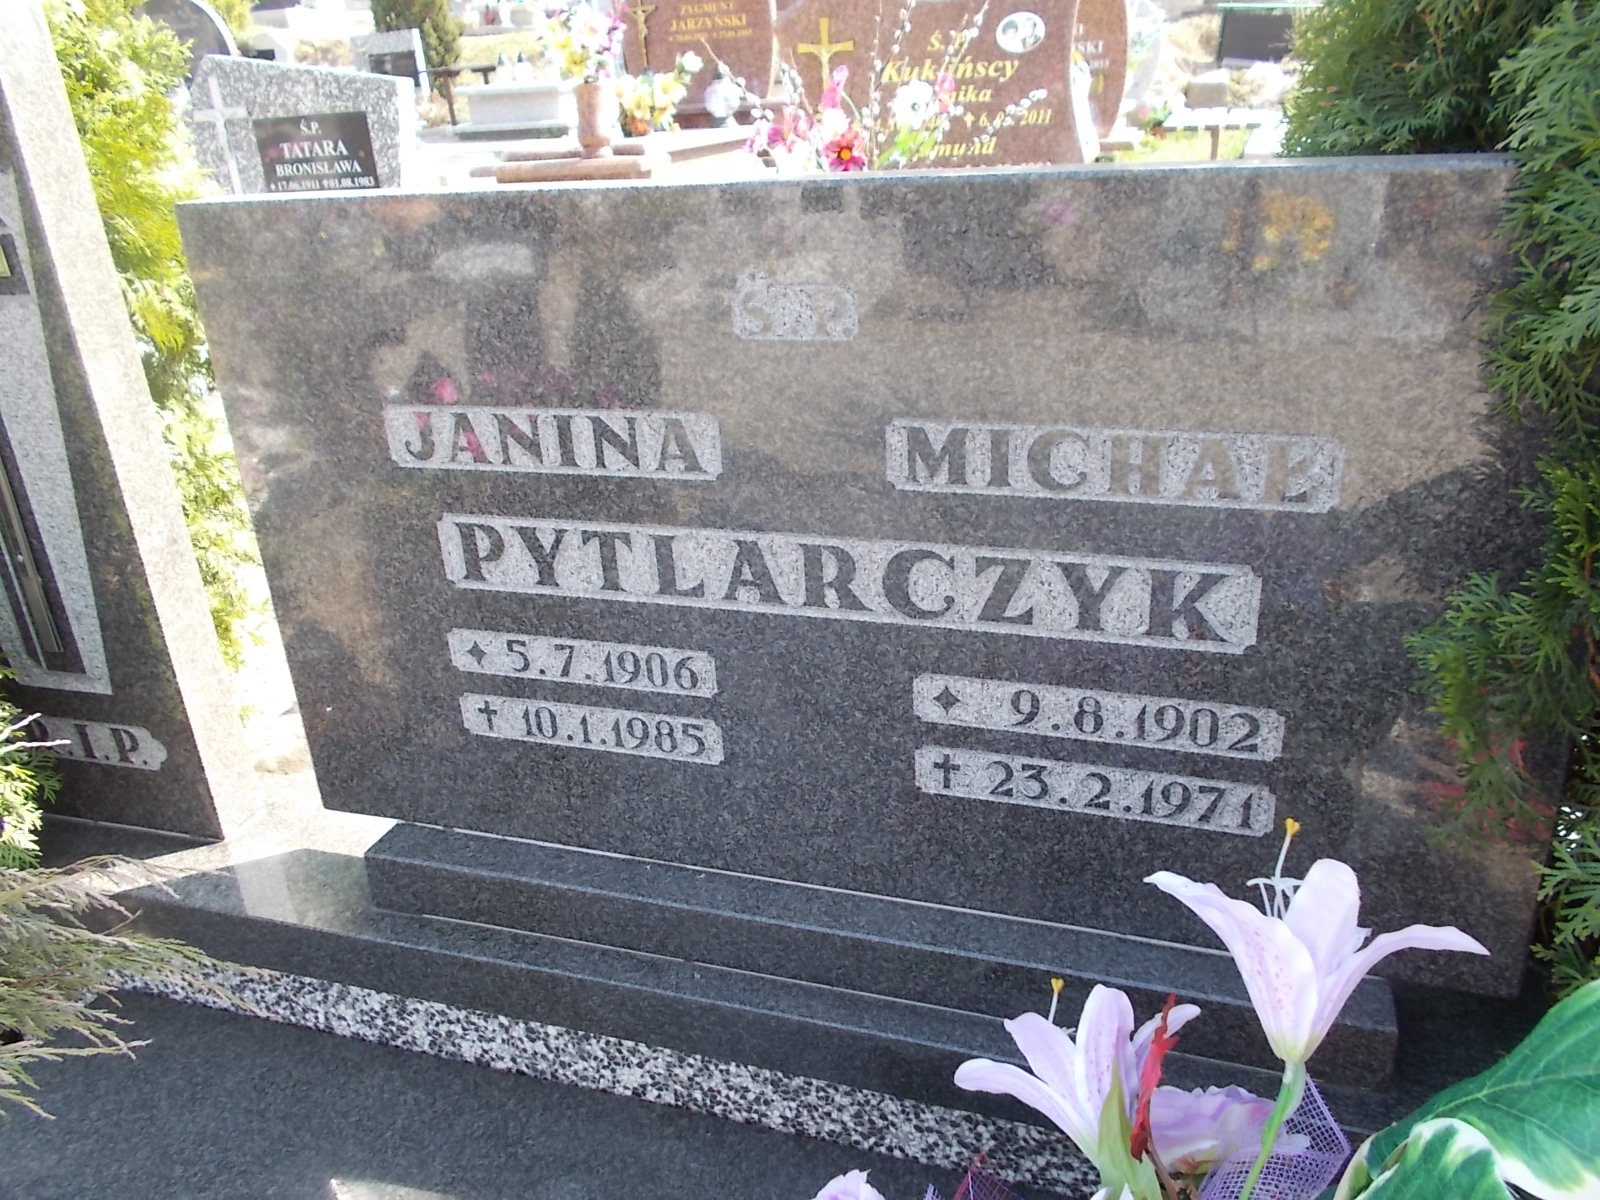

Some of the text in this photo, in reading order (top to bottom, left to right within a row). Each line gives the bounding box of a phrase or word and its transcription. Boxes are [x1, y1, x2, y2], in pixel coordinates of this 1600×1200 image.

[882, 56, 1019, 83] Kukińscy
[279, 139, 348, 159] TATARA
[404, 411, 704, 474] JANINA
[453, 522, 1237, 645] PYTLARCZYK
[505, 639, 699, 690] 5.7.1906
[521, 704, 706, 757] 10.1.1985
[1009, 688, 1261, 753] 9.8.1902
[987, 760, 1254, 830] 23.2.1971
